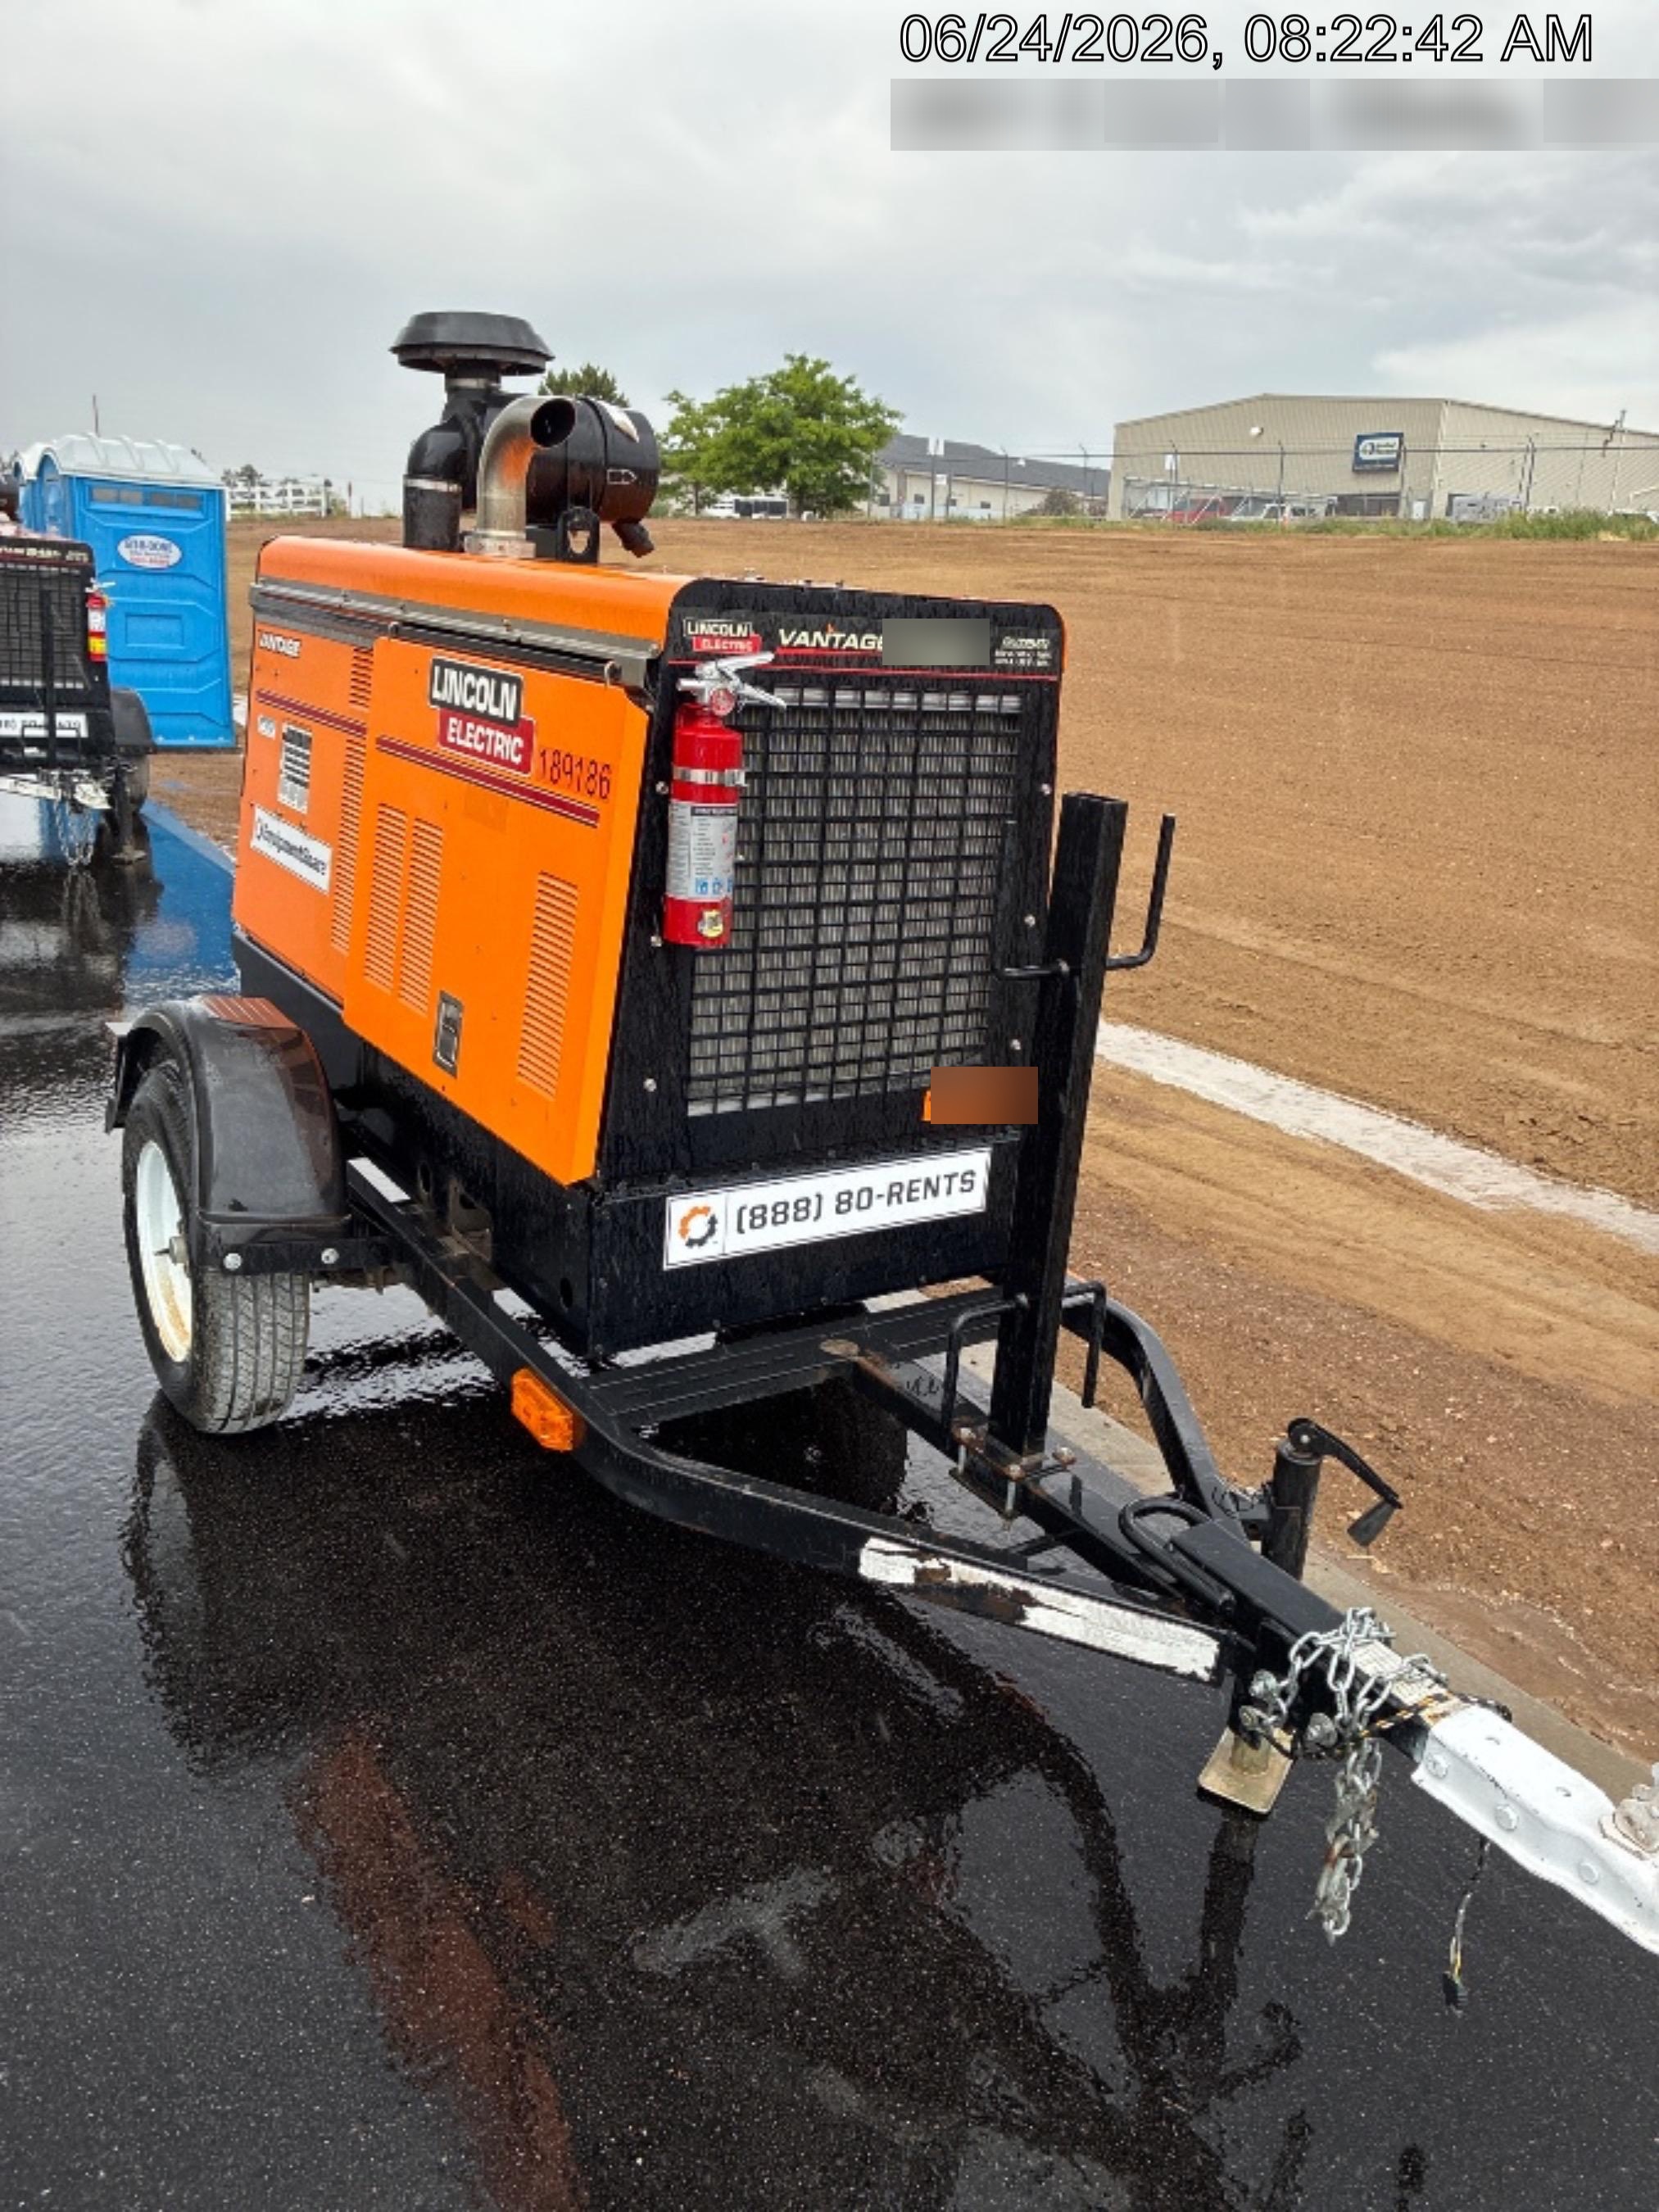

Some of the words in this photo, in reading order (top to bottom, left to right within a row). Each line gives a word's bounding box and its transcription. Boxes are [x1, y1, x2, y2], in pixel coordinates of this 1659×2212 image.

[687, 620, 749, 637] LINCOLN
[778, 628, 883, 650] VANTAG
[432, 664, 518, 722] LINCOLN
[446, 716, 524, 765] ELECTRIC
[539, 749, 613, 800] 189186
[736, 1193, 823, 1235] (888)
[834, 1169, 977, 1216] 80-RENTS
